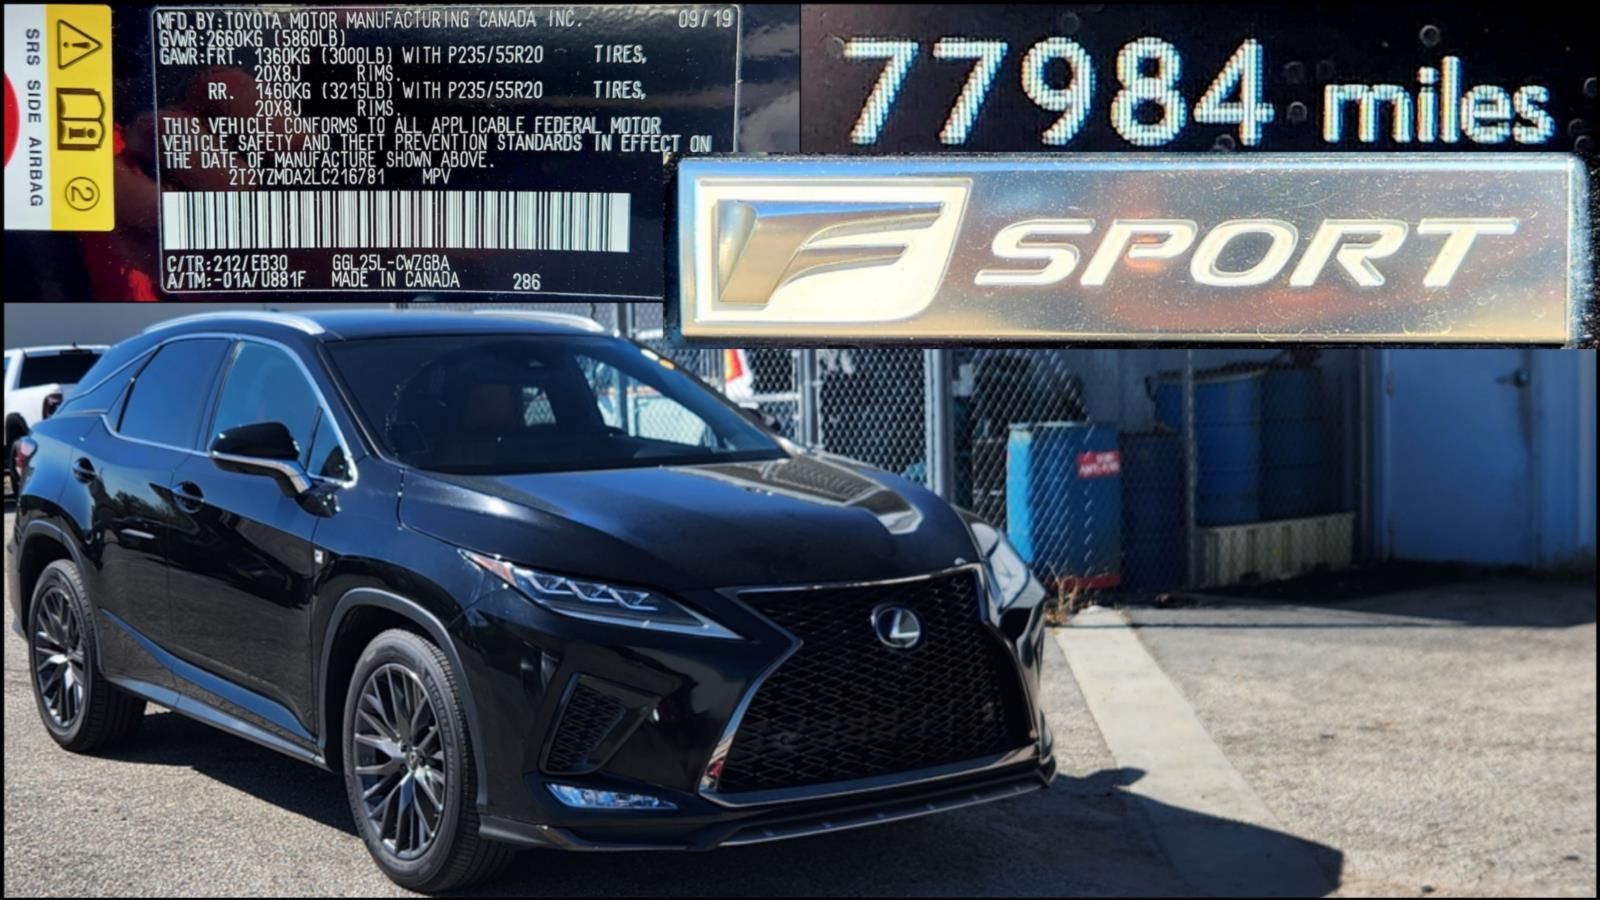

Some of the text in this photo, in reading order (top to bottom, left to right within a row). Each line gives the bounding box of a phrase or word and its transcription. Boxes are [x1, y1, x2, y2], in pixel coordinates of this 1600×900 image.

[157, 10, 732, 29] MFD.BY:TOYOTA MOTOR MANUFACTURING CANADA INC. 09/19
[159, 29, 346, 47] GVWR:2660KG (5860LB)
[159, 45, 647, 65] GAWR:FRT. 1360KG (3000LB) WITH P235/55R20 TIRES,
[254, 65, 401, 82] 20X8J RIMS.
[208, 81, 647, 100] RR. 1460KG (3215LB) WITH P235/55R20 TIRES,
[841, 37, 1554, 147] 77984 miles
[25, 28, 44, 207] SRS SIDE AIRBAG
[255, 100, 401, 117] 20X8J RIMS.
[163, 117, 662, 134] THIS VEHICLE CONFORMS TO ALL APPLICABLE FEDERAL MOTOR
[162, 134, 712, 153] VEHICLE SAFETY AND THEFT PREVENTION STANDARDS IN EFFECT ON
[165, 151, 495, 169] THE DATE OF MANUFACTURE SHOWN ABOVE.
[229, 168, 451, 185] 2T2YZMDA2LC216781 MPV
[973, 217, 1520, 288] SPORT
[166, 255, 450, 272] C/TR:212/EB30 GGL25L-CWZGBA
[166, 271, 460, 289] A/TM:-01A/U881F MADE IN CANADA
[512, 273, 541, 290] 286
